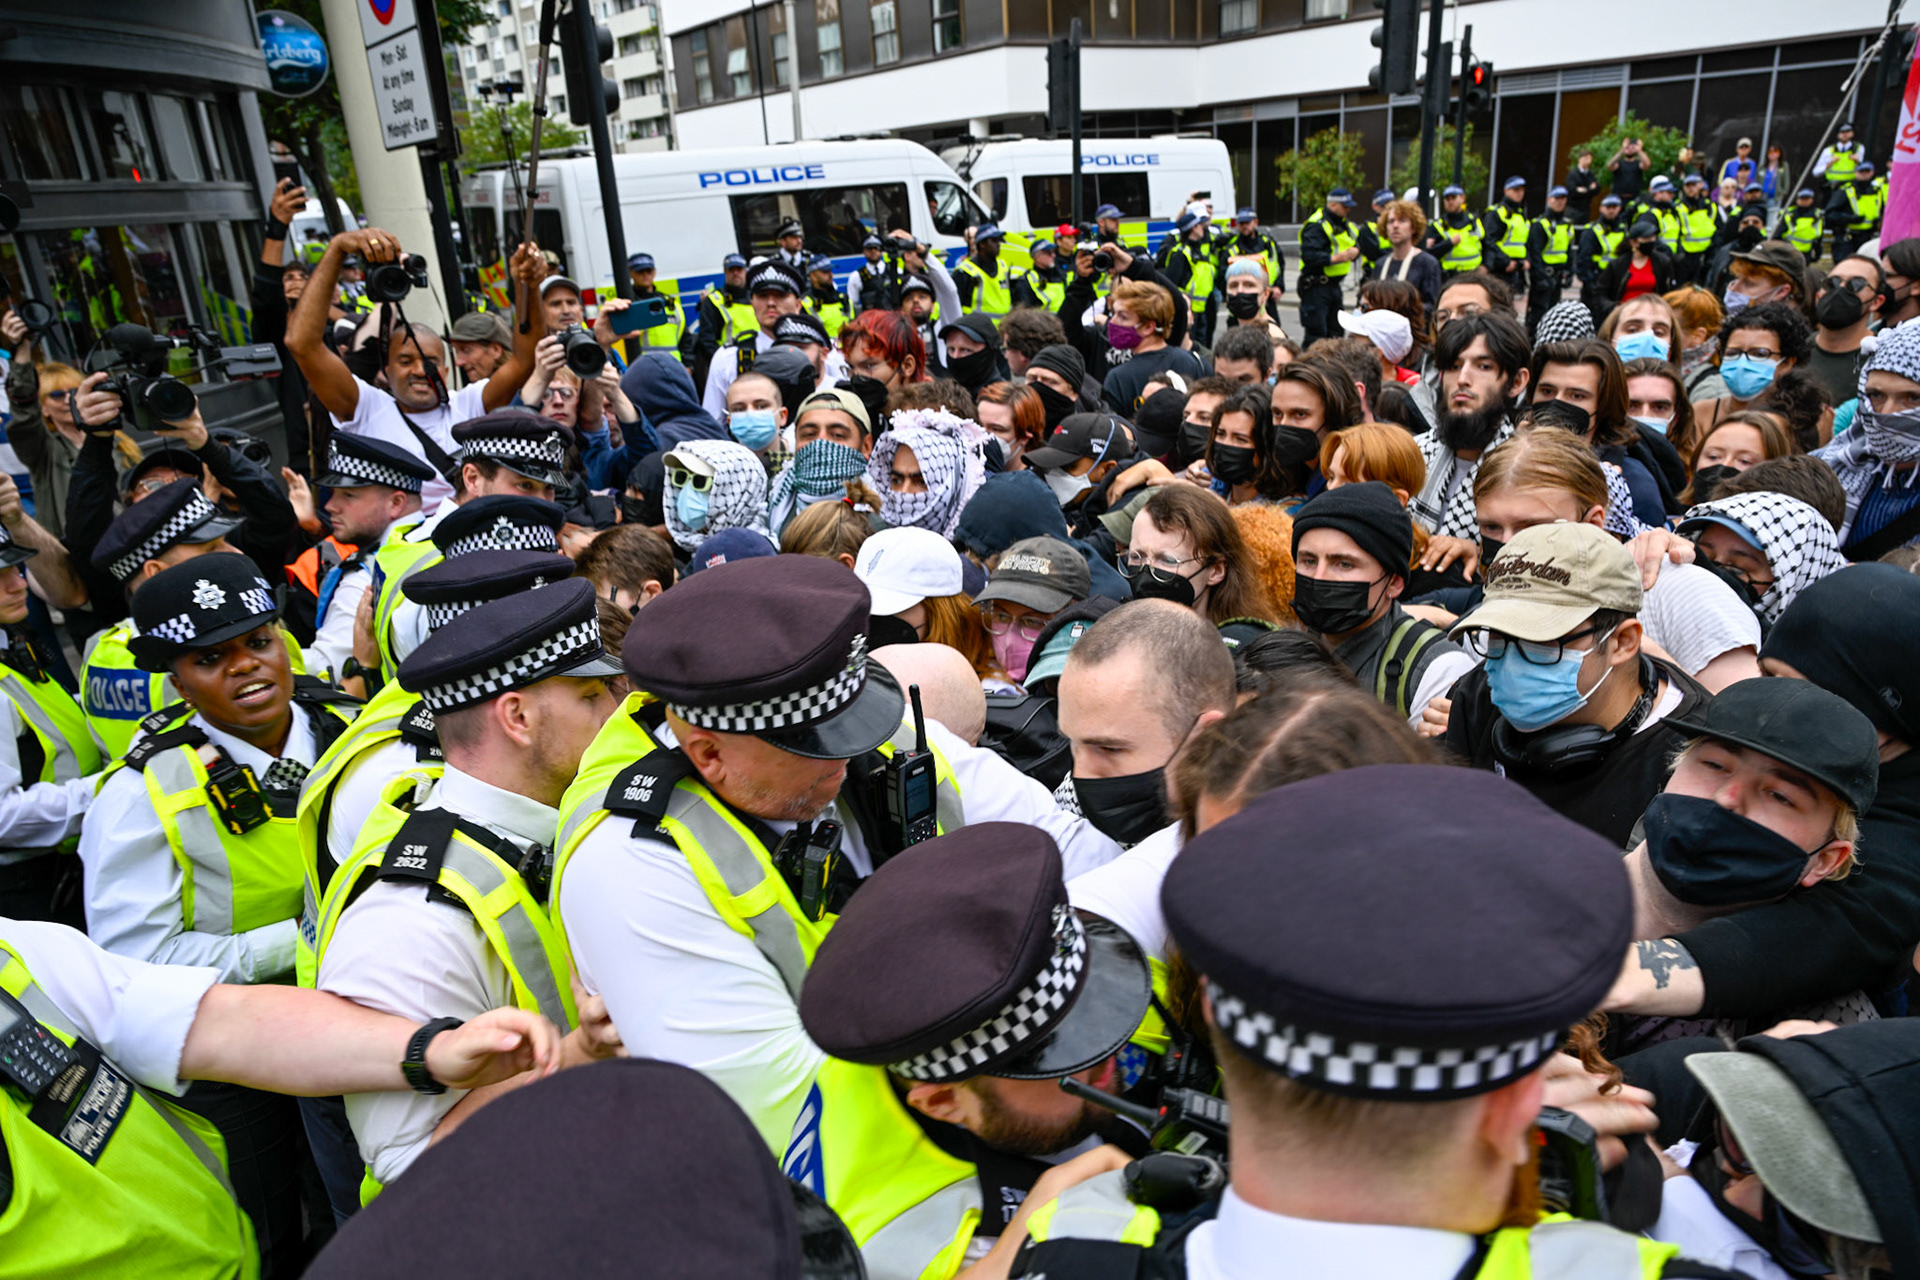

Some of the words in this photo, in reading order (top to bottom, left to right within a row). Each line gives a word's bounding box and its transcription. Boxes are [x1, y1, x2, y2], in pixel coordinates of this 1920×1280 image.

[264, 42, 322, 64] rlsberg
[392, 96, 415, 115] Sunday
[1080, 154, 1160, 168] POLICE
[699, 165, 826, 188] POLICE
[86, 675, 147, 712] POLICE
[410, 715, 435, 731] 2623
[630, 774, 658, 788] SW
[623, 786, 653, 803] 1906
[402, 844, 428, 857] SW
[393, 856, 428, 870] 2622
[83, 1117, 113, 1157] POLICE
[107, 1079, 129, 1119] OFFICER
